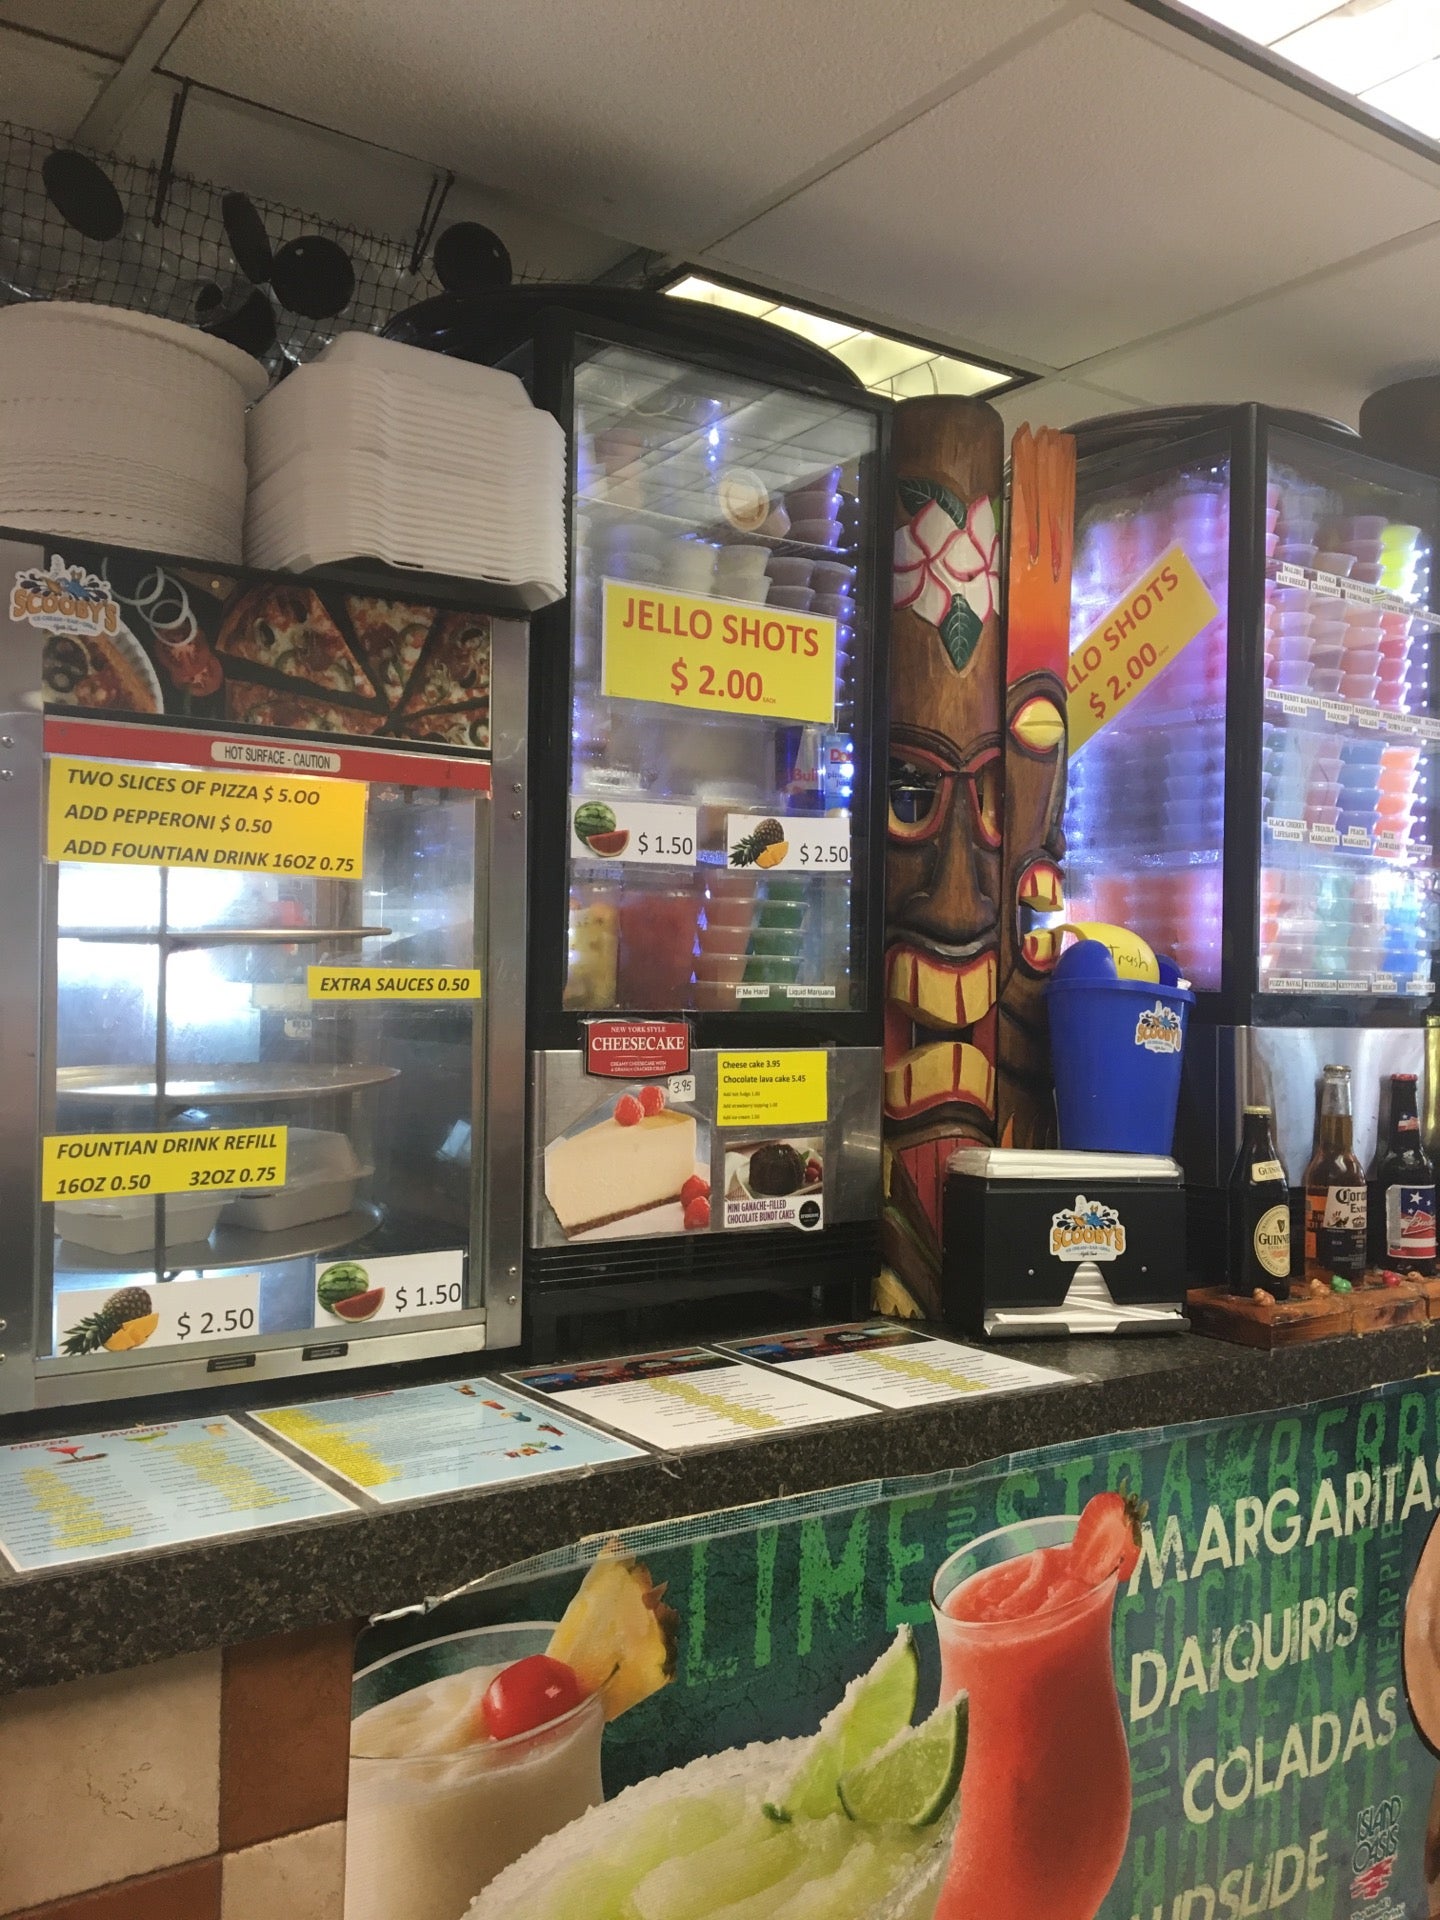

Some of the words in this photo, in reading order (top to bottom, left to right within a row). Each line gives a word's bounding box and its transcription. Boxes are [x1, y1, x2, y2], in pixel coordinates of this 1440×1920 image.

[1312, 583, 1339, 595] CRANBERRY
[1319, 575, 1335, 584] VODKA
[13, 588, 117, 632] SCOOBY'S
[622, 597, 713, 640] JELLO
[722, 614, 819, 657] SHOTS
[1066, 646, 1102, 695] LLO
[1103, 566, 1179, 652] SHOTS
[671, 657, 688, 696] $
[699, 665, 763, 701] 2.00
[1090, 692, 1106, 719] $
[1107, 643, 1157, 701] 2.00
[1267, 690, 1299, 702] STRAWBERRY
[224, 745, 243, 760] HOT
[244, 748, 285, 765] SURFACE
[293, 752, 330, 769] CAUTION
[68, 769, 113, 787] TWO
[118, 773, 176, 793] SLICES
[181, 779, 205, 795] OF
[210, 783, 258, 800] PIZZA
[262, 786, 274, 803] $
[64, 804, 108, 821] ADD
[113, 808, 215, 830] PEPPERONI
[220, 815, 230, 832] $
[235, 817, 272, 834] 0.50
[1269, 820, 1285, 828] BLACK
[1314, 825, 1334, 833] TEQUILA
[638, 835, 649, 855] $
[655, 835, 693, 855] 1.50
[1311, 834, 1338, 843] MARGARITA
[1343, 837, 1370, 847] MARGARITA
[63, 839, 107, 856] ADD
[111, 842, 209, 864] FOUNTIAN
[213, 849, 269, 867] DRINK
[320, 857, 354, 872] 0.75
[800, 844, 809, 864] $
[814, 846, 849, 863] 2.50
[1106, 944, 1148, 972] Trash
[320, 978, 371, 991] EXTRA
[376, 978, 434, 991] SAUCES
[438, 978, 470, 991] 0.50
[592, 1036, 685, 1051] CHEESECAKE
[722, 1061, 747, 1069] Cheese
[750, 1060, 764, 1068] cake
[766, 1060, 780, 1068] 3.95
[723, 1075, 757, 1083] Chocolate
[760, 1075, 773, 1083] lava
[57, 1139, 158, 1159] FOUNTIAN
[162, 1136, 225, 1153] DRINK
[225, 1134, 277, 1150] REFILL
[110, 1174, 151, 1191] 0.50
[239, 1167, 276, 1182] 0.75
[728, 1203, 740, 1213] MINI
[741, 1200, 786, 1212] GANACHE-FILLED
[728, 1213, 758, 1224] CHOCOLATE
[760, 1211, 777, 1221] BUNDT
[779, 1210, 795, 1219] CAKES
[1053, 1227, 1123, 1252] SCOOBY'S
[395, 1286, 408, 1312] $
[415, 1283, 461, 1307] 1.50
[177, 1312, 191, 1340] $
[200, 1308, 254, 1334] 2.50
[10, 1439, 70, 1451] FROZEN
[101, 1424, 179, 1438] FAVORITES
[1182, 1686, 1397, 1824] COLADAS
[1356, 1795, 1401, 1844] ISLAND
[1352, 1823, 1400, 1876] OASIS
